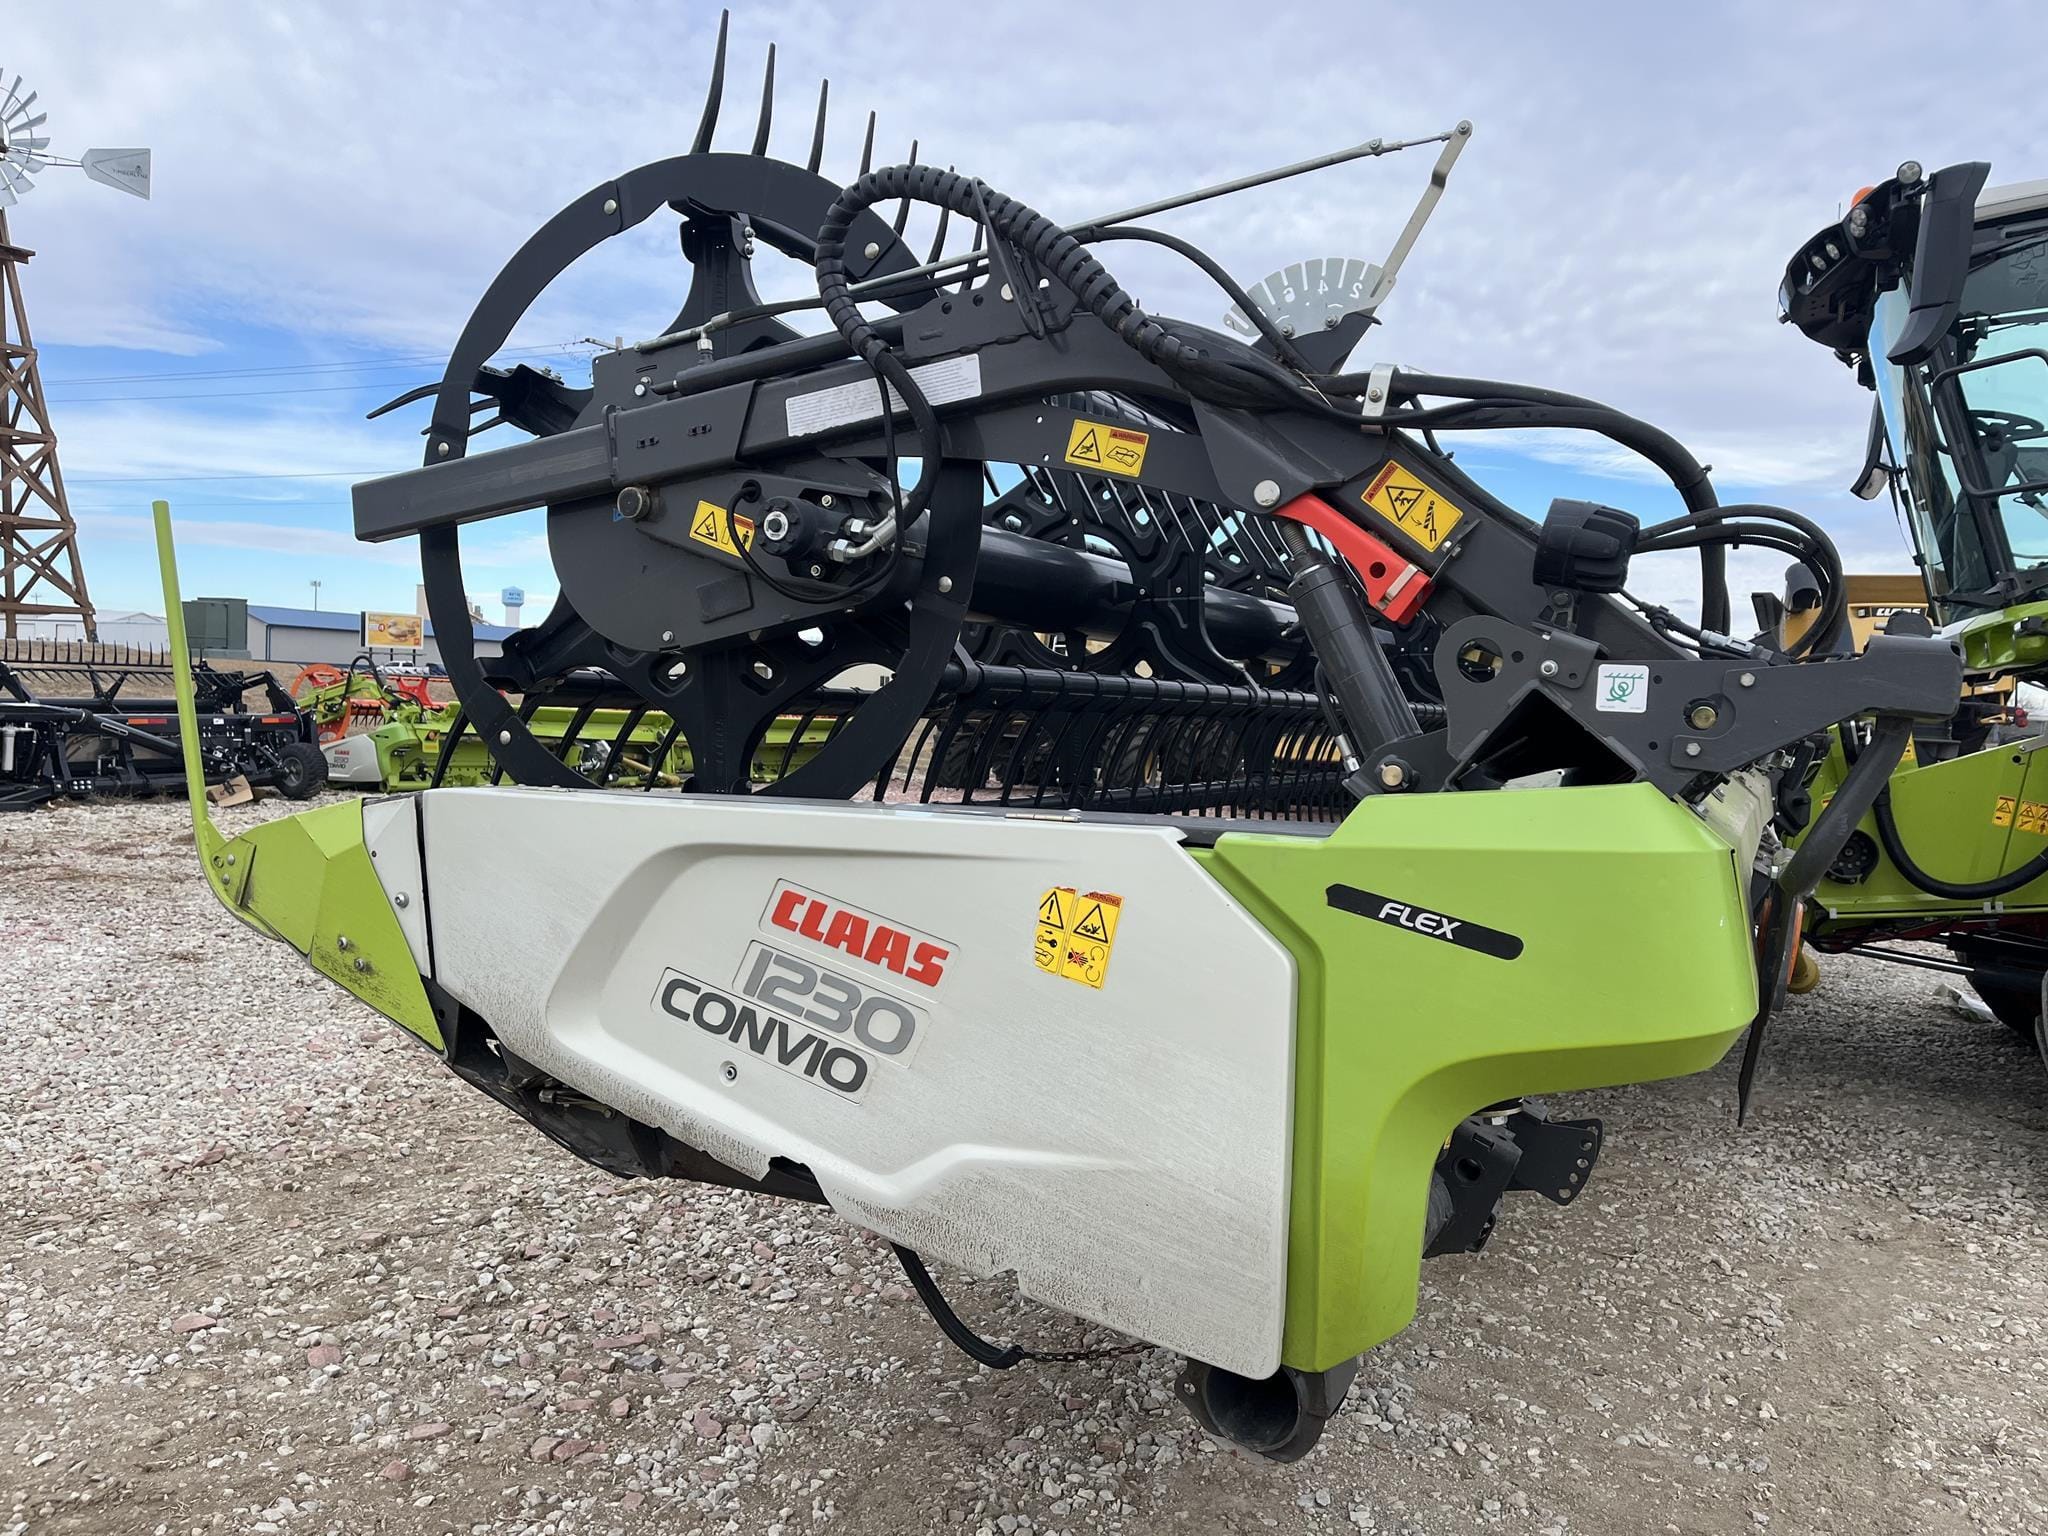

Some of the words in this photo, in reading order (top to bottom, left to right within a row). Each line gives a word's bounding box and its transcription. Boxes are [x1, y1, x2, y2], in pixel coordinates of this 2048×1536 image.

[771, 889, 950, 987] CLAAS
[1378, 902, 1462, 940] FLEX
[661, 978, 868, 1093] CONVIO
[742, 948, 916, 1055] 1230
